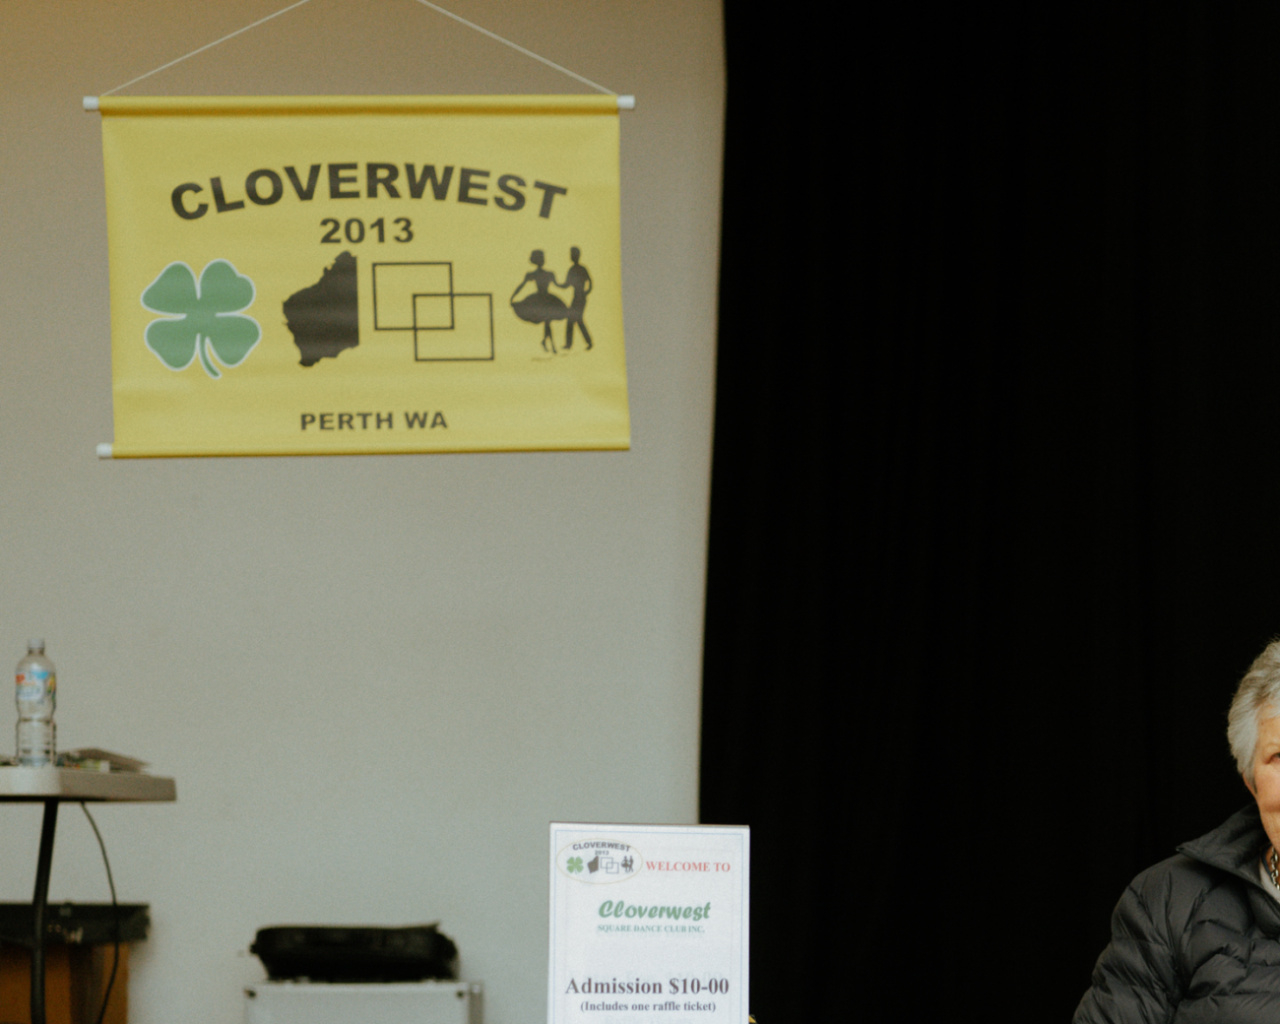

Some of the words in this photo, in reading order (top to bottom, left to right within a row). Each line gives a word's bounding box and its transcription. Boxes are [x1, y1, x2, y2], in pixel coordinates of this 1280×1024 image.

[171, 162, 568, 220] CLOVERWEST
[320, 217, 414, 244] 2013
[301, 411, 394, 431] PERTH
[404, 410, 448, 430] WA
[572, 841, 631, 852] CLOVERWEST
[646, 861, 711, 872] WELCOME
[713, 862, 731, 872] TO
[598, 900, 711, 921] Cloverwest
[597, 925, 631, 933] SQUARE
[565, 978, 663, 995] Admission
[668, 978, 729, 995] $10-00
[580, 1002, 629, 1012] (Includes
[652, 1002, 681, 1011] raffle
[683, 1002, 716, 1012] ticket)
